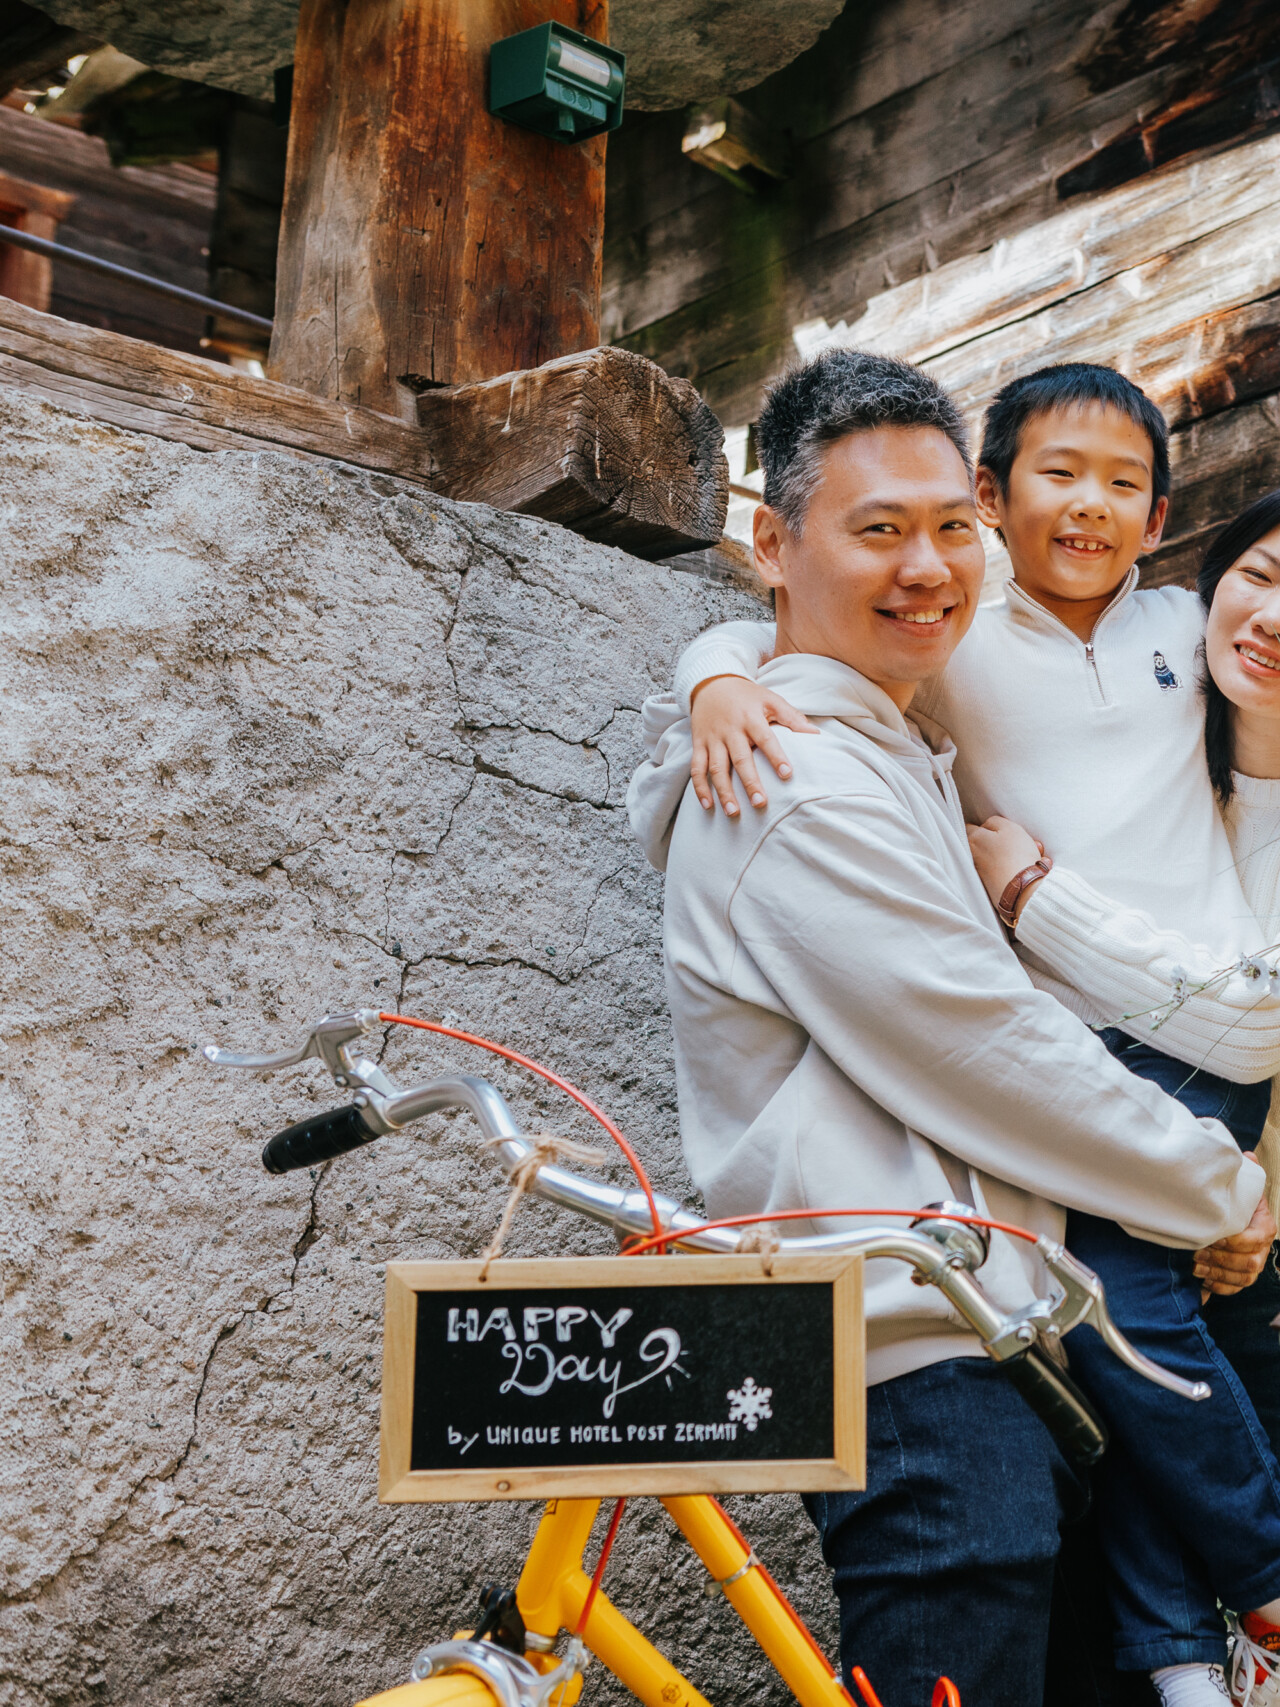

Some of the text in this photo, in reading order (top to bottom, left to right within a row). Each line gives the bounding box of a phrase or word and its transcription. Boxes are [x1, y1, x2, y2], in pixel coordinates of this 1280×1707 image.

[447, 1306, 633, 1348] HAPPY
[499, 1328, 682, 1419] Day
[446, 1422, 739, 1455] by UNIQUE HOTEL POST ZERMATT
